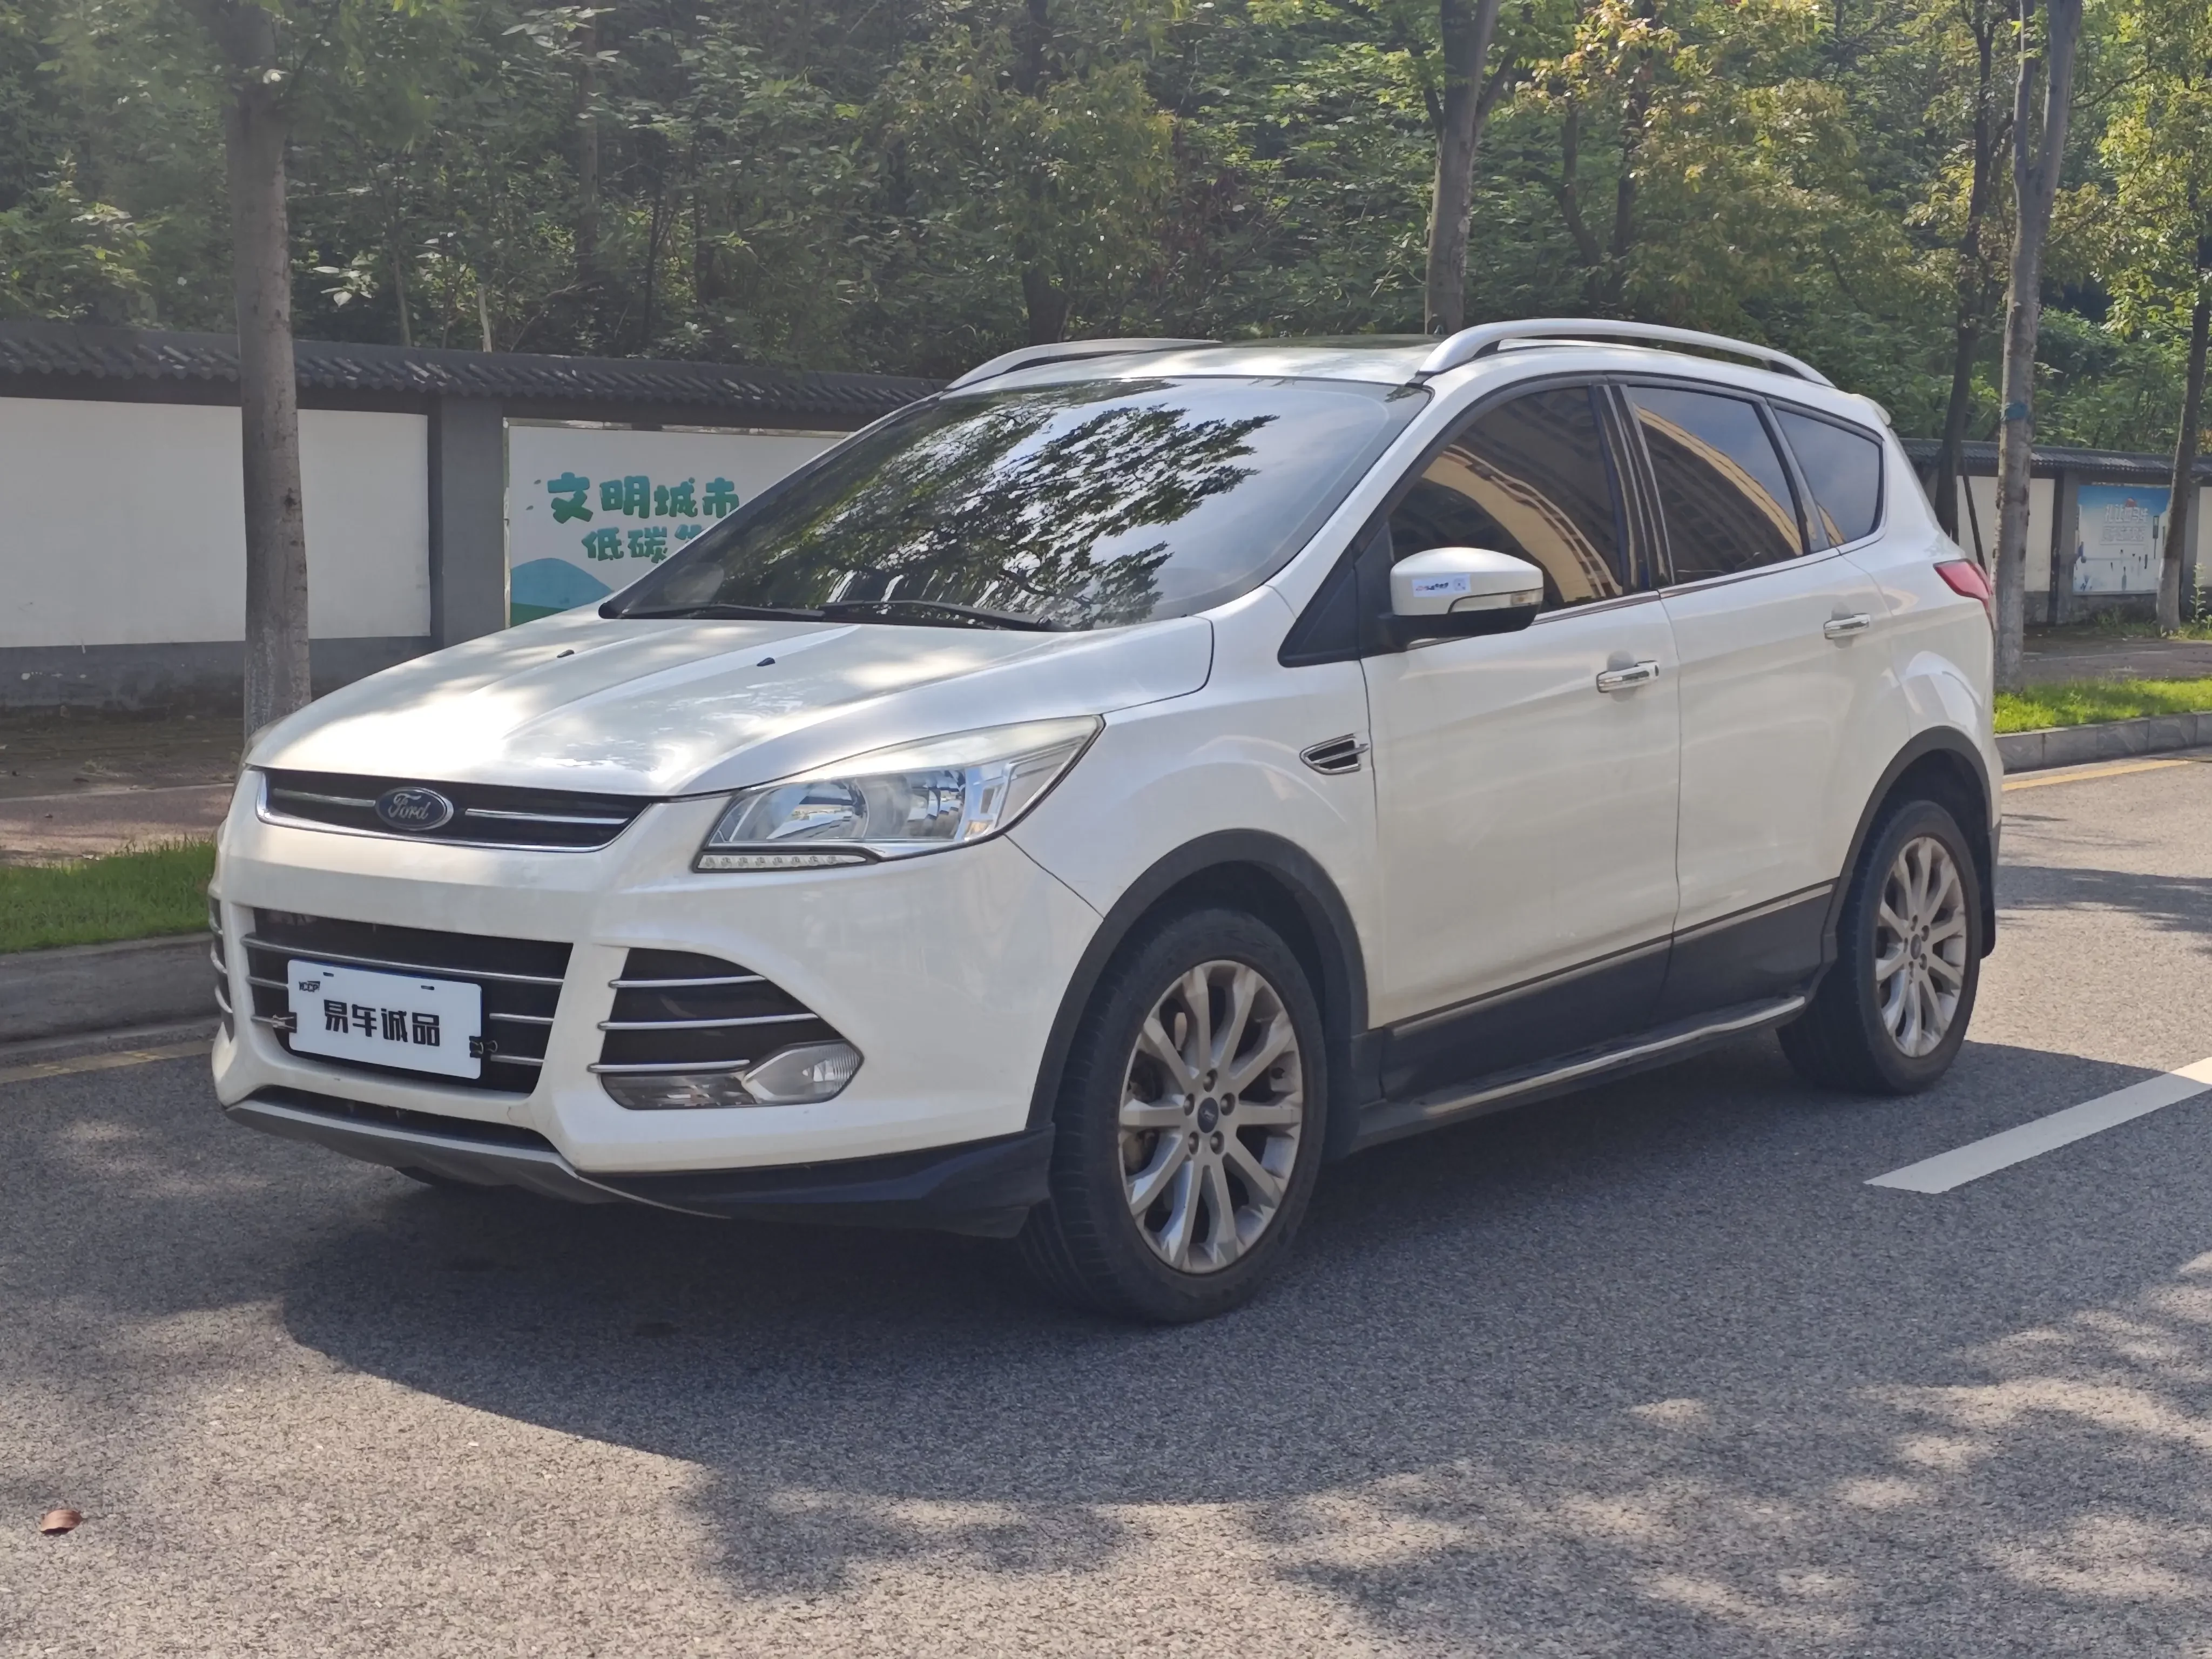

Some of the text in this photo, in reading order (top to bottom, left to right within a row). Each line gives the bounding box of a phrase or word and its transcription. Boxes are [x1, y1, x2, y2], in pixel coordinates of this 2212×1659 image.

[547, 471, 739, 524] 文明城市
[388, 793, 431, 820] Ford
[323, 999, 440, 1047] 易车诚品
